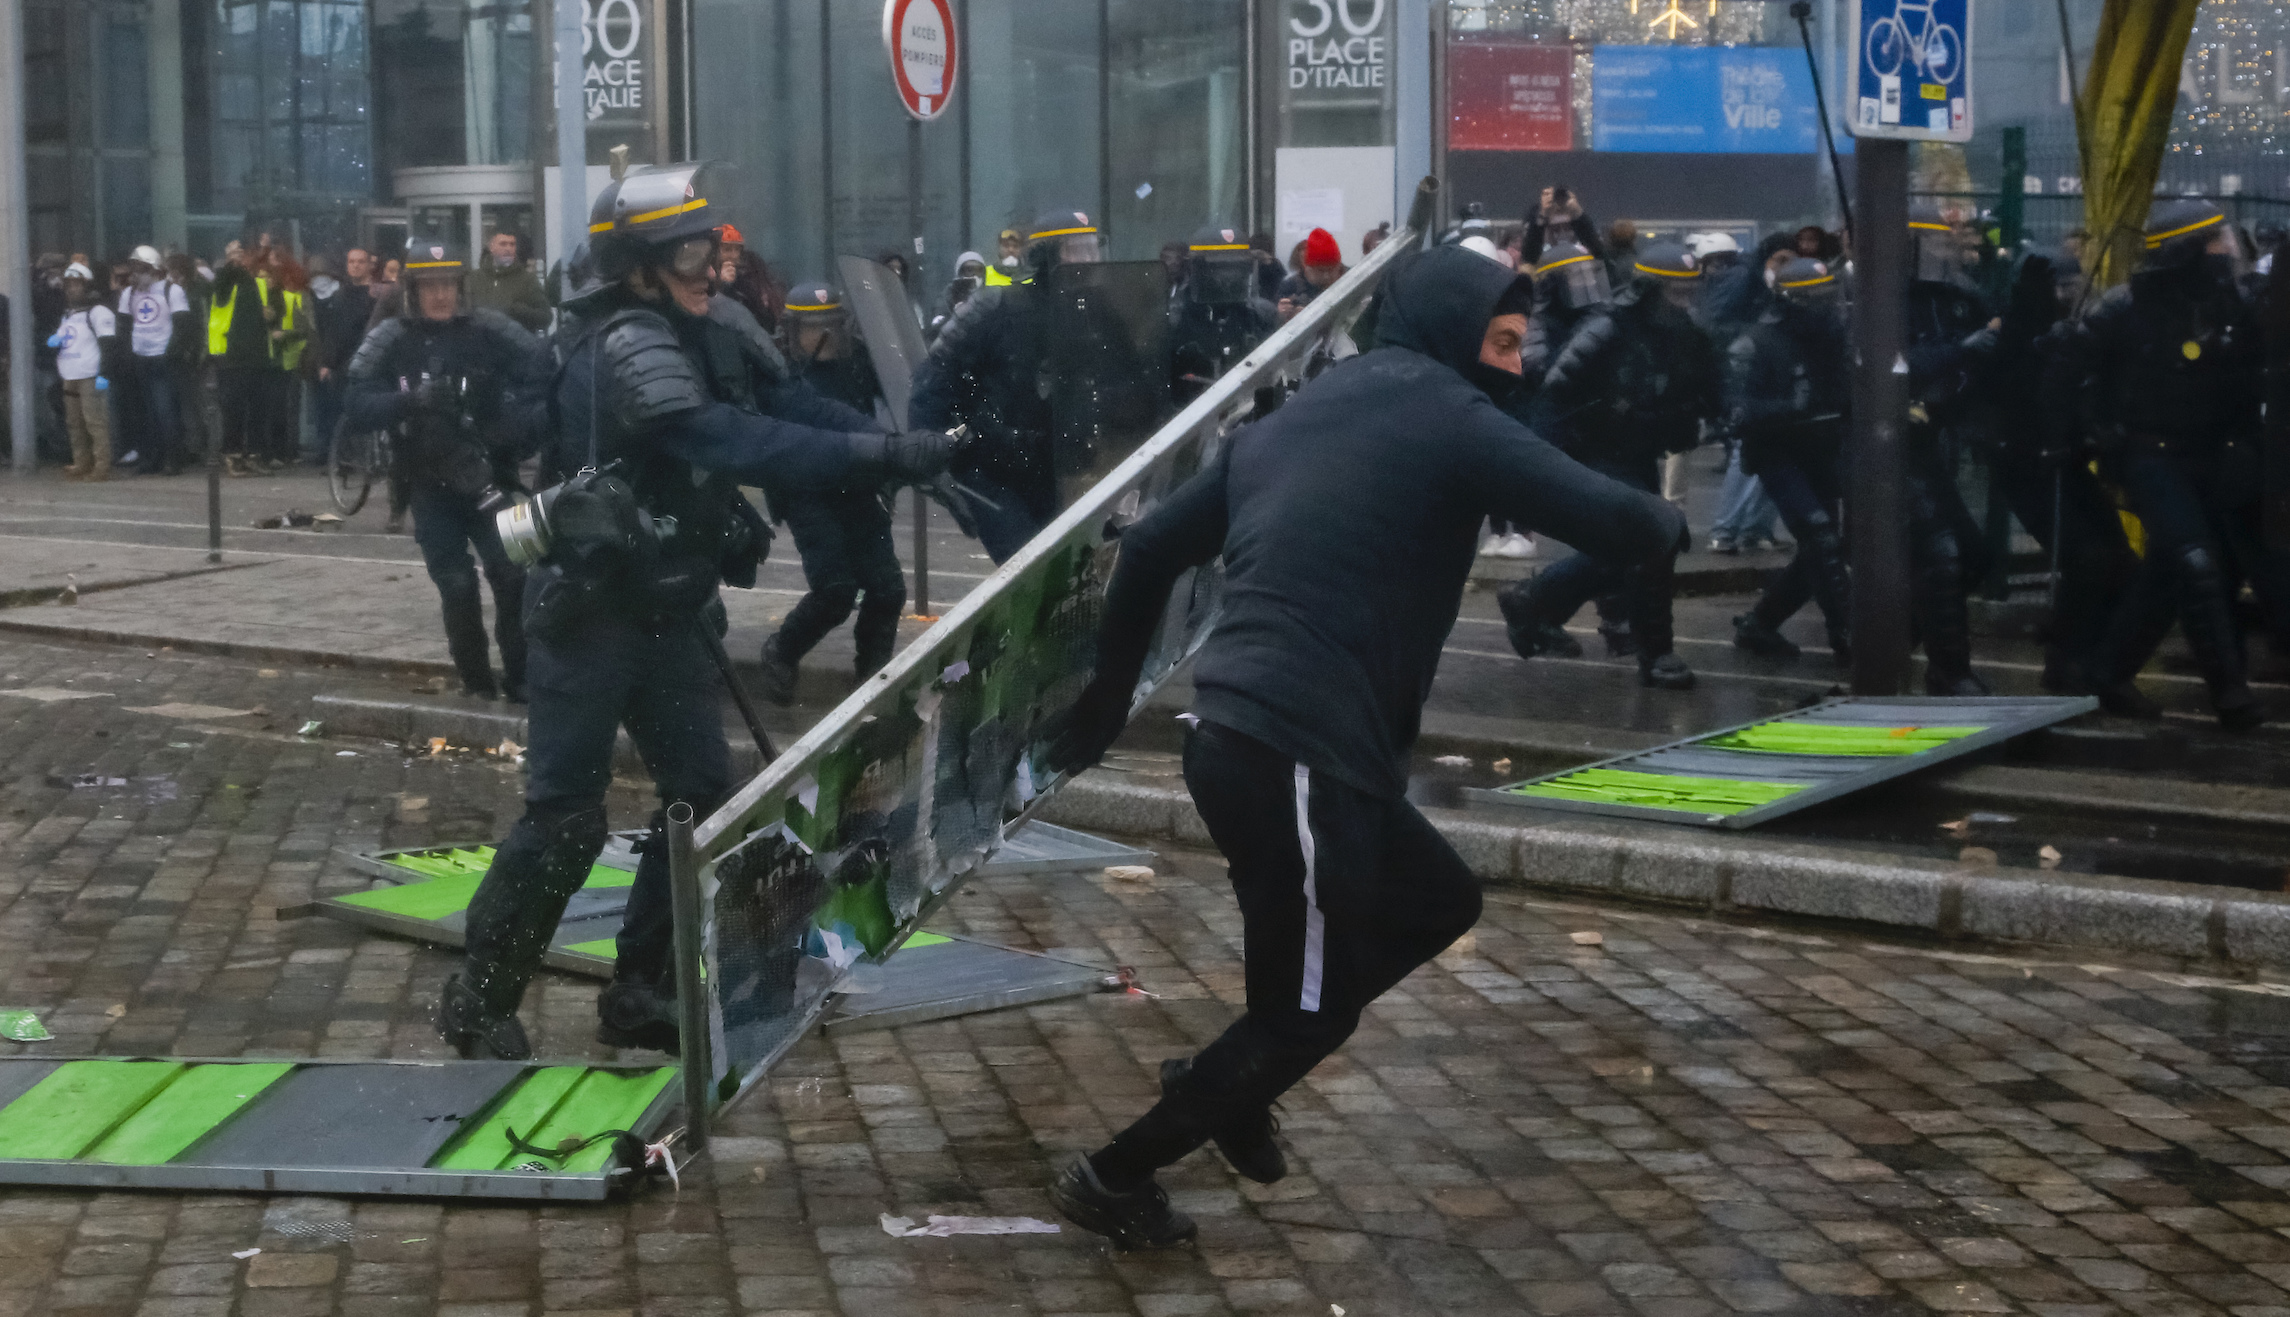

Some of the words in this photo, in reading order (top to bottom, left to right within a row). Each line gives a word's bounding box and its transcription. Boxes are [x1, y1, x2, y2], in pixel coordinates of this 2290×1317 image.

[903, 48, 945, 68] POMPIERS
[1289, 37, 1384, 66] PLACE
[553, 60, 641, 86] ACE
[1289, 65, 1384, 89] D'ITALIE
[1722, 103, 1782, 129] Ville
